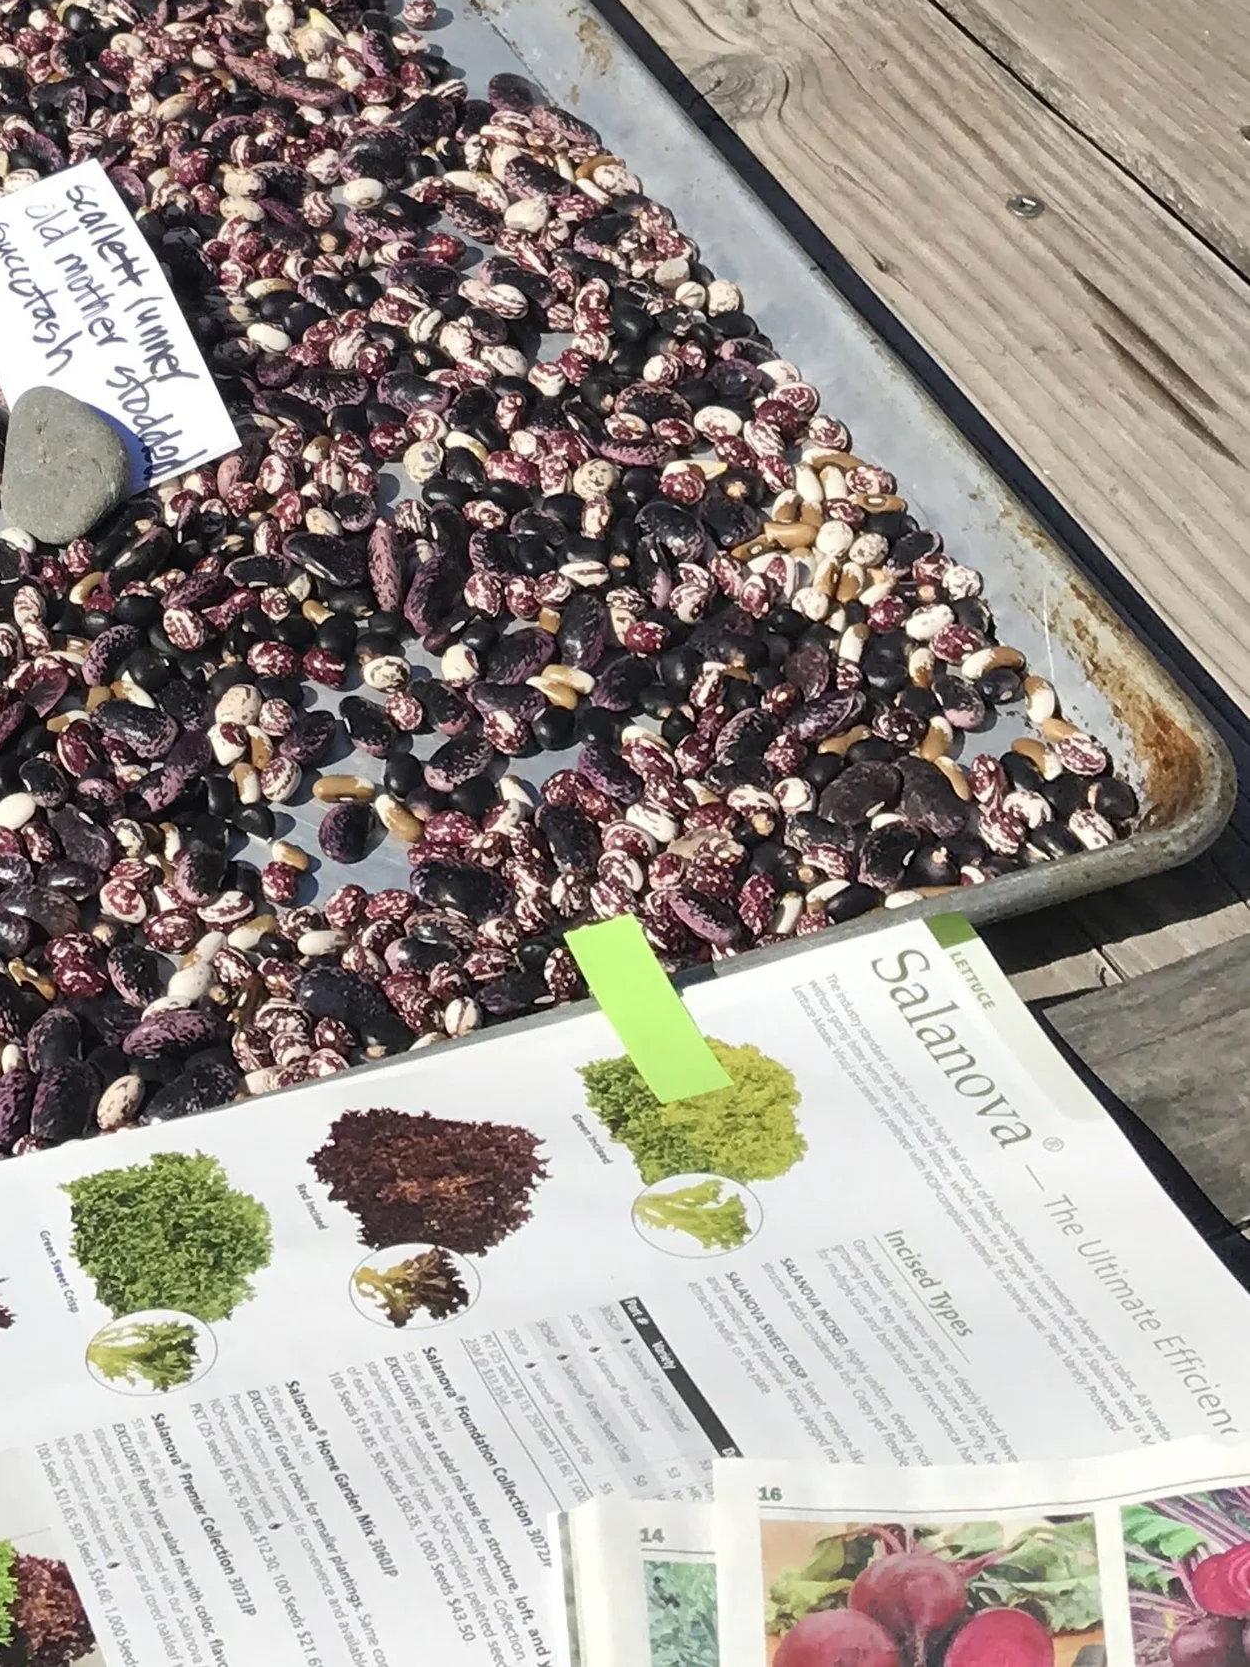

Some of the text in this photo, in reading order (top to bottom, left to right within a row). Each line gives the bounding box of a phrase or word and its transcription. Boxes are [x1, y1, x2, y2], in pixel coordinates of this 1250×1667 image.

[24, 203, 80, 248] old
[54, 253, 129, 346] mother
[65, 184, 200, 383] scarlett runner
[949, 951, 996, 1010] LETTUCE
[571, 1113, 614, 1165] Green Incised
[295, 1182, 329, 1230] Red Incised
[39, 1230, 79, 1313] Green Sweet Crisp
[883, 1229, 973, 1337] Incised Types
[1043, 1193, 1084, 1236] The
[1077, 1239, 1161, 1332] Ultimate
[624, 1299, 643, 1317] Part
[652, 1340, 676, 1368] Variety
[724, 1271, 766, 1323] SALANOVA
[758, 1323, 790, 1353] SWEET
[779, 1257, 822, 1309] SALANOVA
[843, 1348, 869, 1374] Highly
[890, 1413, 918, 1443] deeply
[911, 1444, 933, 1467] incis
[852, 1238, 874, 1264] Open
[887, 1288, 909, 1309] with
[943, 1363, 959, 1376] on
[953, 1376, 982, 1405] deeply
[975, 1405, 1004, 1435] lobed
[993, 1434, 1019, 1463] leave
[189, 1402, 208, 1420] PKT
[228, 1393, 251, 1426] Premier
[34, 1442, 53, 1460] 100
[205, 1438, 230, 1467] seeds)
[243, 1427, 271, 1469] Collection
[454, 1405, 498, 1466] Foundation
[492, 1467, 533, 1527] Collection
[41, 1460, 62, 1488] Seeds
[263, 1468, 280, 1486] but
[327, 1371, 347, 1390] 100
[337, 1390, 359, 1417] Seeds
[369, 1450, 389, 1469] 500
[379, 1469, 403, 1495] Seeds
[415, 1531, 440, 1562] 1,000
[430, 1562, 455, 1596] Seeds
[429, 1475, 449, 1496] with
[758, 1486, 783, 1502] 16
[239, 1508, 263, 1535] Seeds
[246, 1389, 379, 1646] EXCLUSIVE! Great choice for smaller plantings. Same
[315, 1439, 340, 1472] Home
[333, 1473, 363, 1513] Garden
[356, 1514, 376, 1537] Mix
[368, 1538, 399, 1577] 3060JP
[383, 1356, 423, 1411] EXCLUSIVE!
[414, 1411, 431, 1430] Use
[424, 1430, 438, 1442] as
[435, 1450, 461, 1474] salad
[451, 1474, 469, 1493] mix
[461, 1492, 482, 1517] base
[476, 1518, 492, 1534] for
[484, 1537, 518, 1594] structure,
[514, 1595, 535, 1625] loft,
[527, 1628, 551, 1657] and
[440, 1495, 457, 1511] the
[111, 1422, 146, 1477] EXCLUSIVE!
[136, 1478, 158, 1508] Refine
[147, 1508, 169, 1530] your
[160, 1530, 185, 1556] salad
[173, 1557, 191, 1578] mix
[183, 1577, 204, 1603] with
[194, 1604, 215, 1637] color,
[178, 1472, 207, 1515] Premier
[200, 1516, 235, 1575] Collection
[227, 1576, 257, 1616] 3073JP
[291, 1522, 308, 1537] for
[448, 1511, 479, 1555] Salanova
[639, 1527, 665, 1543] 14
[76, 1541, 97, 1568] Seeds
[299, 1537, 335, 1596] convenience
[472, 1555, 500, 1596] Premier
[272, 1573, 292, 1594] 100
[281, 1595, 305, 1629] Seeds
[327, 1597, 349, 1620] and
[296, 1630, 324, 1667] $21.6
